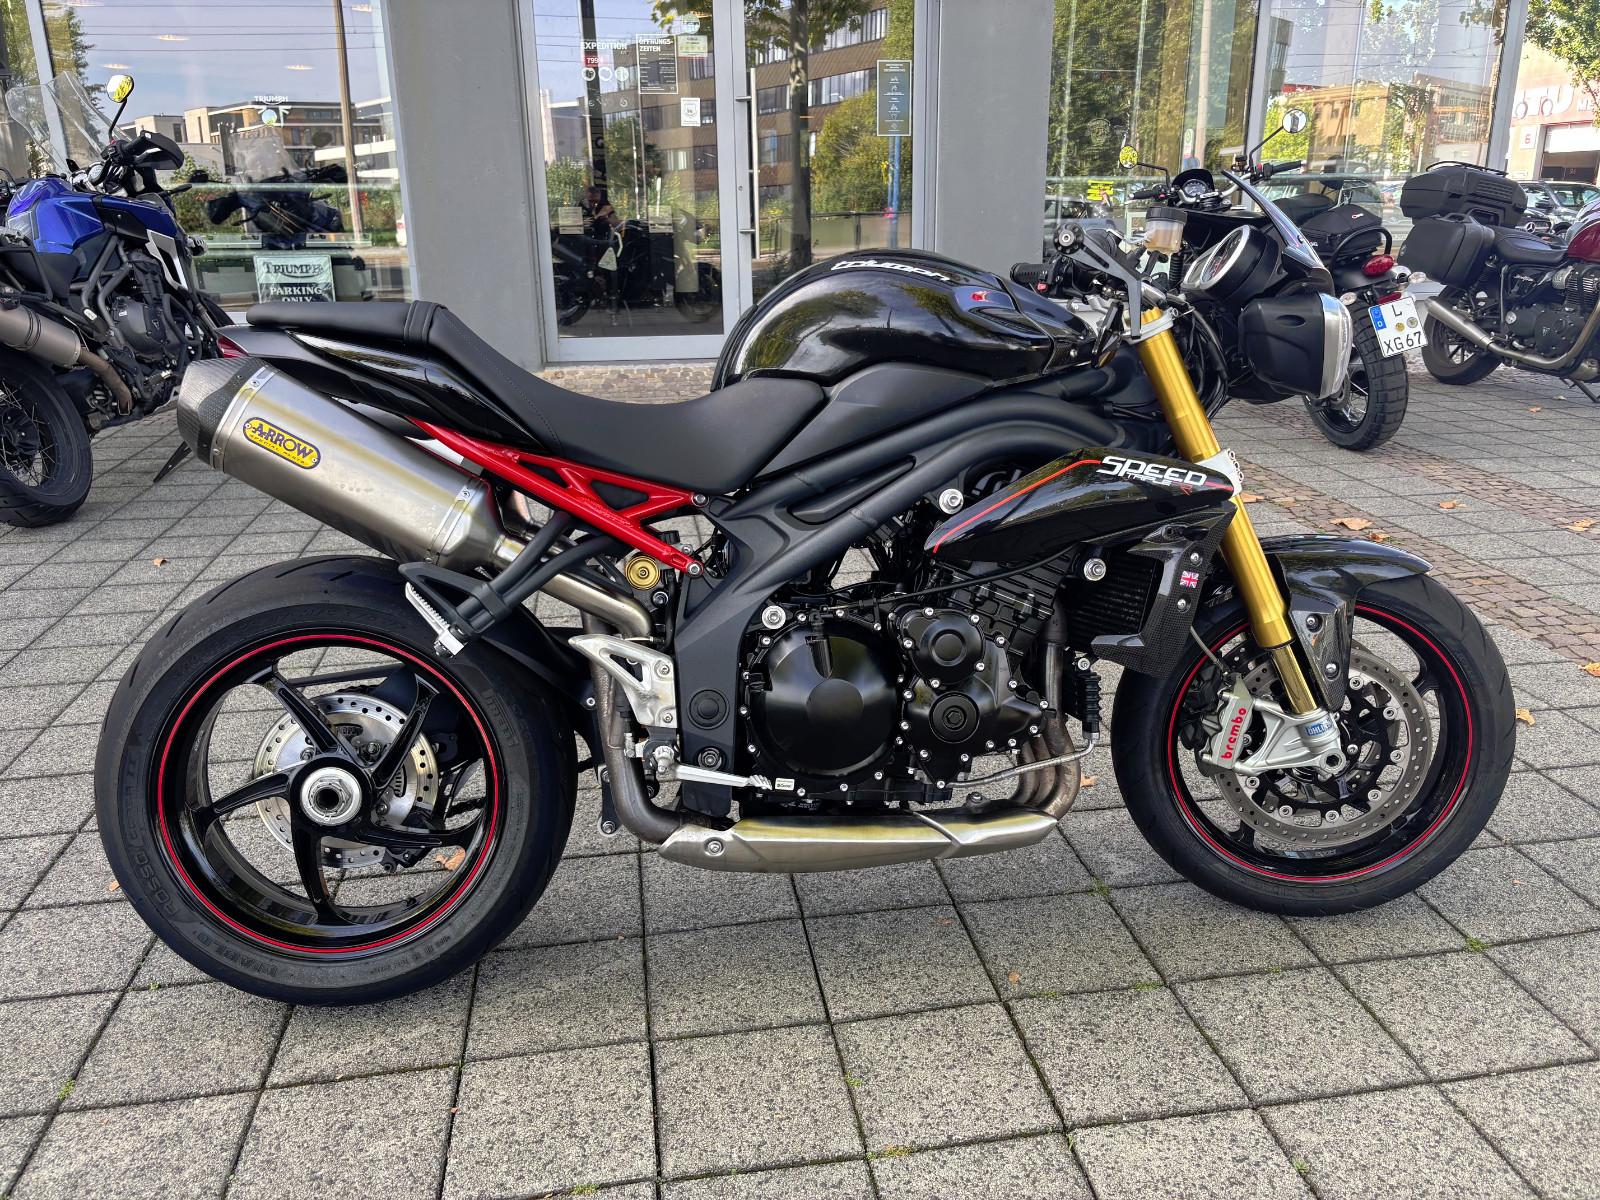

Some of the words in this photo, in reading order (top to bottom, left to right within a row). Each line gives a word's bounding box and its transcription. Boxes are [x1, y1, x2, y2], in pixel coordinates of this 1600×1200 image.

[581, 41, 628, 50] EXPEDITION
[263, 261, 323, 274] TRIUMPH
[270, 286, 322, 295] PARKING
[1392, 304, 1403, 317] L
[1384, 336, 1404, 354] XG
[1406, 330, 1421, 348] 67
[252, 422, 314, 459] ARROW
[1096, 455, 1208, 486] SPEED
[1220, 707, 1248, 760] brembo
[133, 851, 180, 917] ROSSO
